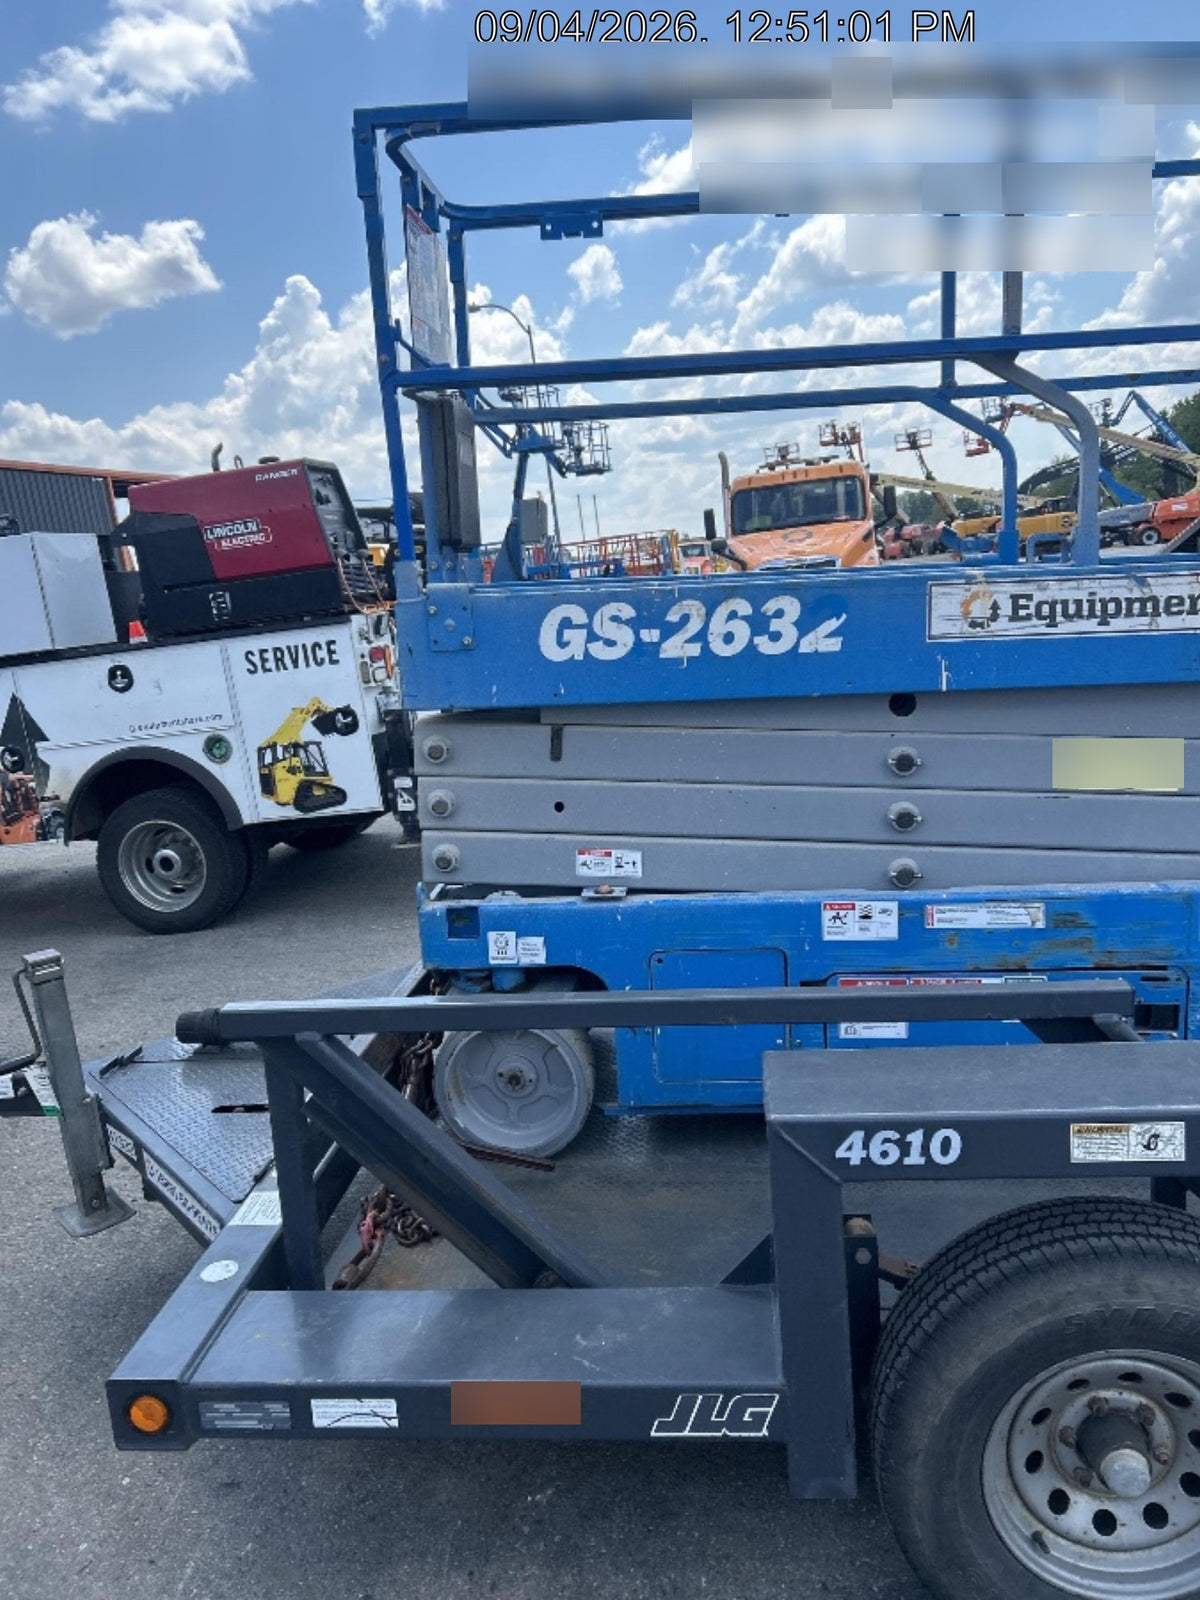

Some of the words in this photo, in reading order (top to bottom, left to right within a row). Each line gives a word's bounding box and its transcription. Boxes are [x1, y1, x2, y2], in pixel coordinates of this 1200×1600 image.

[538, 595, 848, 662] GS-2632
[243, 639, 341, 676] SERVICE
[834, 1127, 964, 1166] 4610
[649, 1393, 780, 1437] JLG
